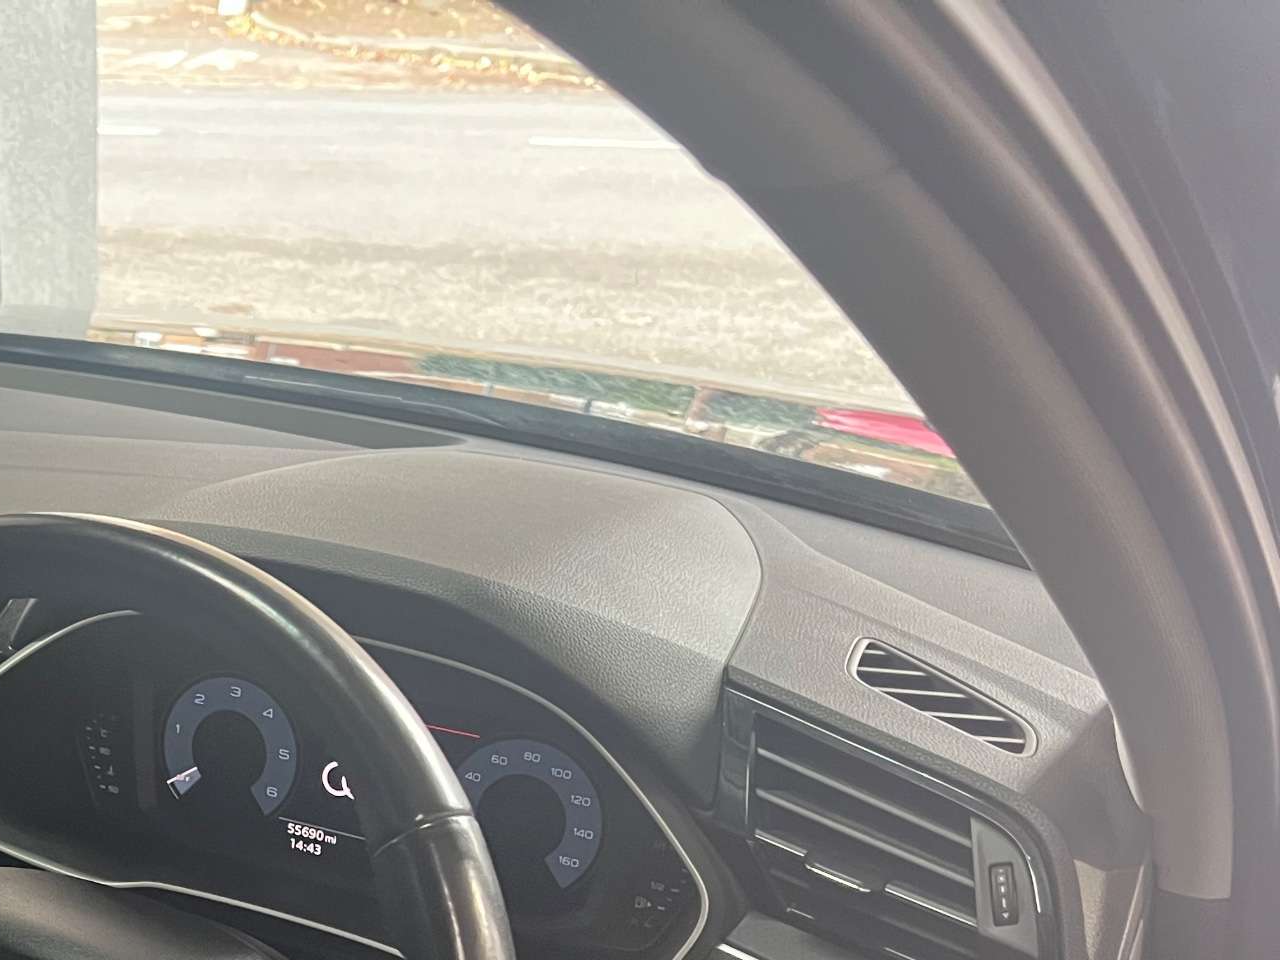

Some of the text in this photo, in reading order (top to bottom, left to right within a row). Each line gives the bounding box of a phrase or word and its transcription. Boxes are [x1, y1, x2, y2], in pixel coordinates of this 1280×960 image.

[230, 686, 242, 698] 3
[194, 693, 205, 705] 2
[262, 707, 274, 719] 4
[175, 723, 181, 735] 1
[278, 748, 290, 761] 5
[491, 754, 508, 766] 60
[523, 751, 541, 763] 80
[464, 771, 481, 783] 40
[551, 767, 572, 780] 100
[266, 786, 278, 798] 6
[570, 795, 591, 807] 120
[287, 822, 337, 845] 55690 mi
[573, 827, 594, 840] 140
[290, 838, 322, 856] 14:43
[558, 855, 580, 868] 160
